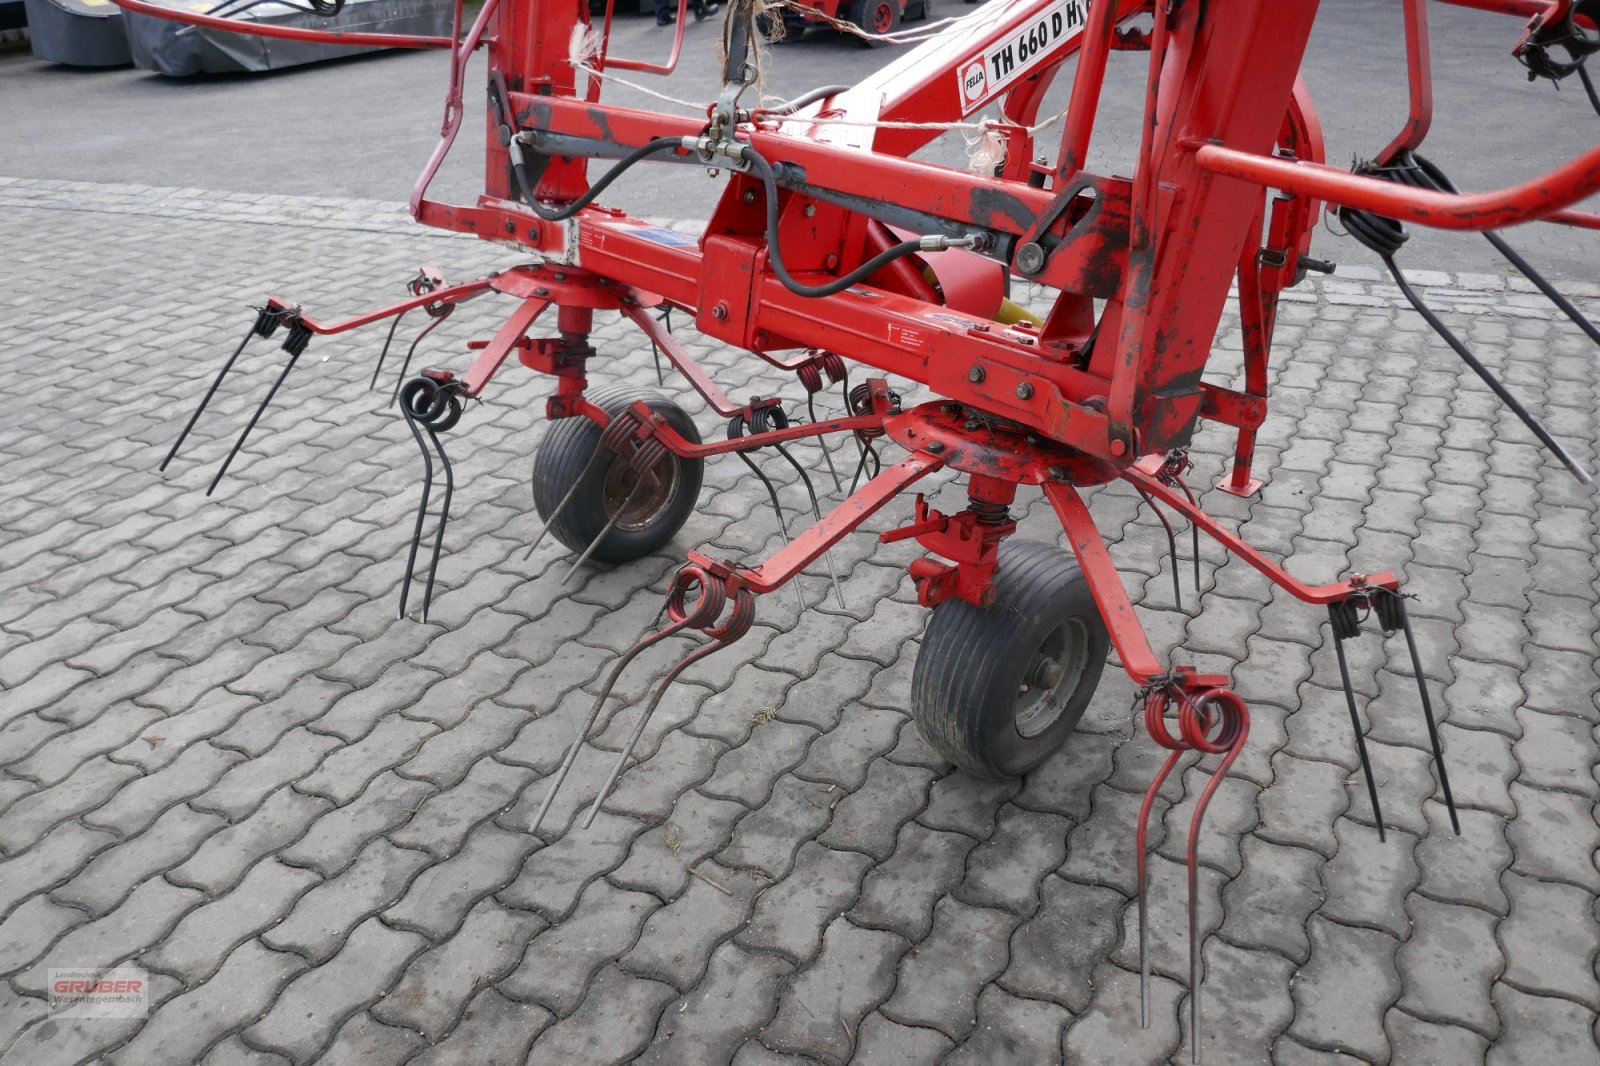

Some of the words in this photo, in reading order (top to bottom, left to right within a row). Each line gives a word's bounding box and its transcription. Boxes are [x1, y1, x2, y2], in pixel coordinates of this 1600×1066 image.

[991, 44, 1015, 81] TH
[1018, 20, 1048, 63] 660
[1051, 11, 1063, 39] D
[965, 70, 984, 91] FELLA
